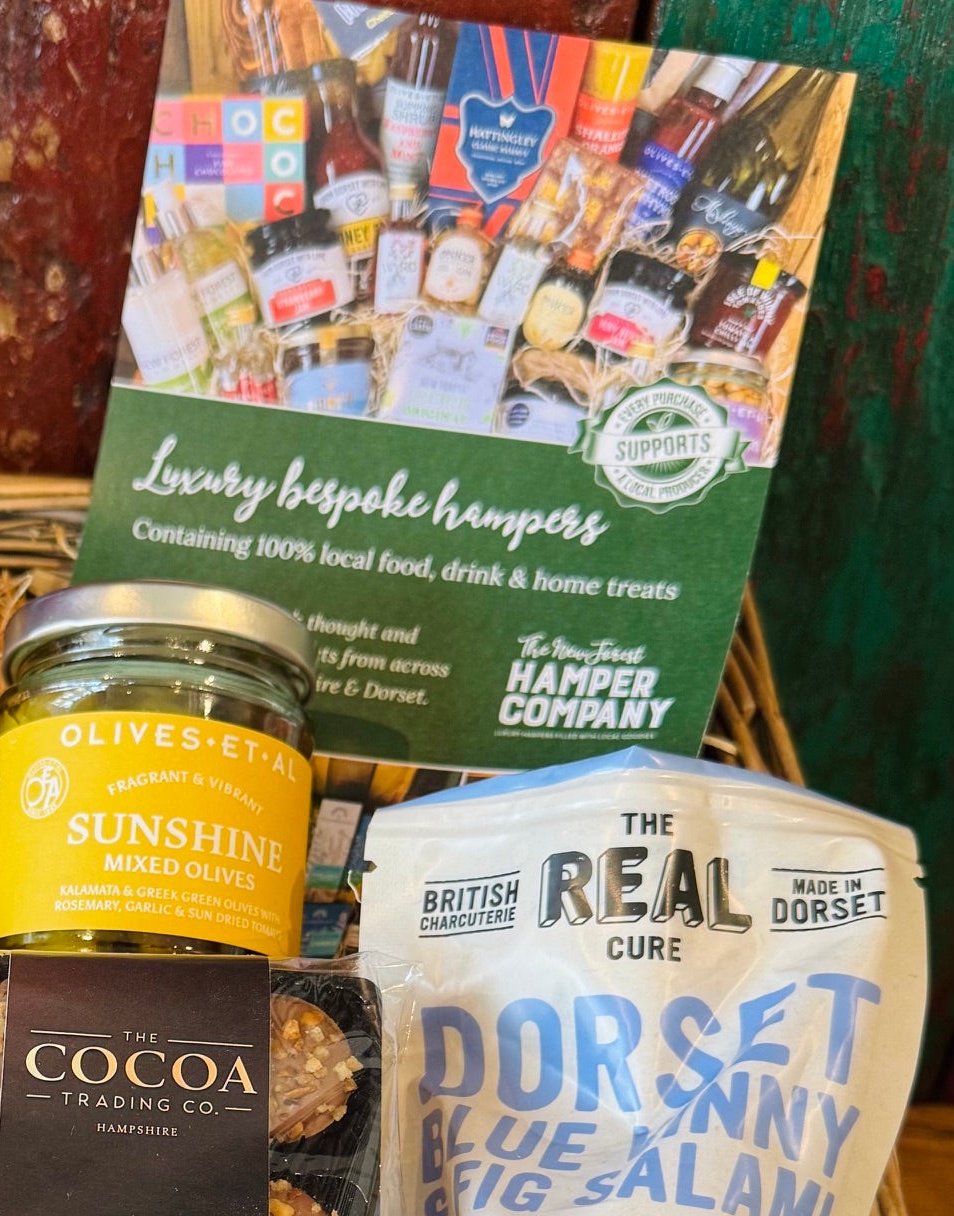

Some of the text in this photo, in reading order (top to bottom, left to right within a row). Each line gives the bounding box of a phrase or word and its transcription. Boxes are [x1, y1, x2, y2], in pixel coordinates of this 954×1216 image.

[617, 396, 651, 423] EVERY
[652, 392, 707, 419] PURCHASE
[615, 433, 711, 461] SUPPORTS
[133, 433, 610, 551] Luxury bespoke hampers
[132, 518, 680, 601] Containing 100% local food, drink & home treats
[307, 612, 377, 642] thought
[381, 625, 421, 645] and
[336, 646, 386, 671] from
[390, 656, 452, 678] across
[518, 631, 646, 665] The New Forest
[344, 678, 360, 697] &
[363, 680, 429, 706] Dorset.
[506, 659, 660, 698] HAMPER
[499, 693, 676, 729] COMPANY
[106, 770, 264, 816] FRAGRANT & VIBRANT
[621, 813, 674, 836] THE
[66, 812, 284, 874] SUNSHINE
[103, 853, 256, 891] MIXED OLIVES
[792, 877, 862, 896] MADE IN
[59, 884, 121, 897] KALAMATA
[123, 885, 134, 897] &
[137, 886, 179, 901] GREEK
[181, 891, 221, 908] GREEN
[223, 898, 259, 918] OLIVES
[422, 879, 519, 914] BRITISH
[537, 846, 752, 934] REAL
[54, 899, 123, 913] ROSEMARY,
[125, 901, 172, 916] GARLIC
[174, 905, 185, 918] &
[187, 906, 213, 921] SUN
[215, 912, 249, 929] DRIED
[420, 906, 516, 931] CHARCUTERIE
[771, 890, 885, 925] DORSET
[606, 936, 682, 962] CURE
[123, 1031, 158, 1043] THE
[419, 973, 882, 1113] DORSET
[25, 1043, 258, 1095] COCOA
[61, 1092, 219, 1115] TRADING CO.
[97, 1123, 178, 1137] HAMPSHIRE
[421, 1105, 598, 1185] BLUE
